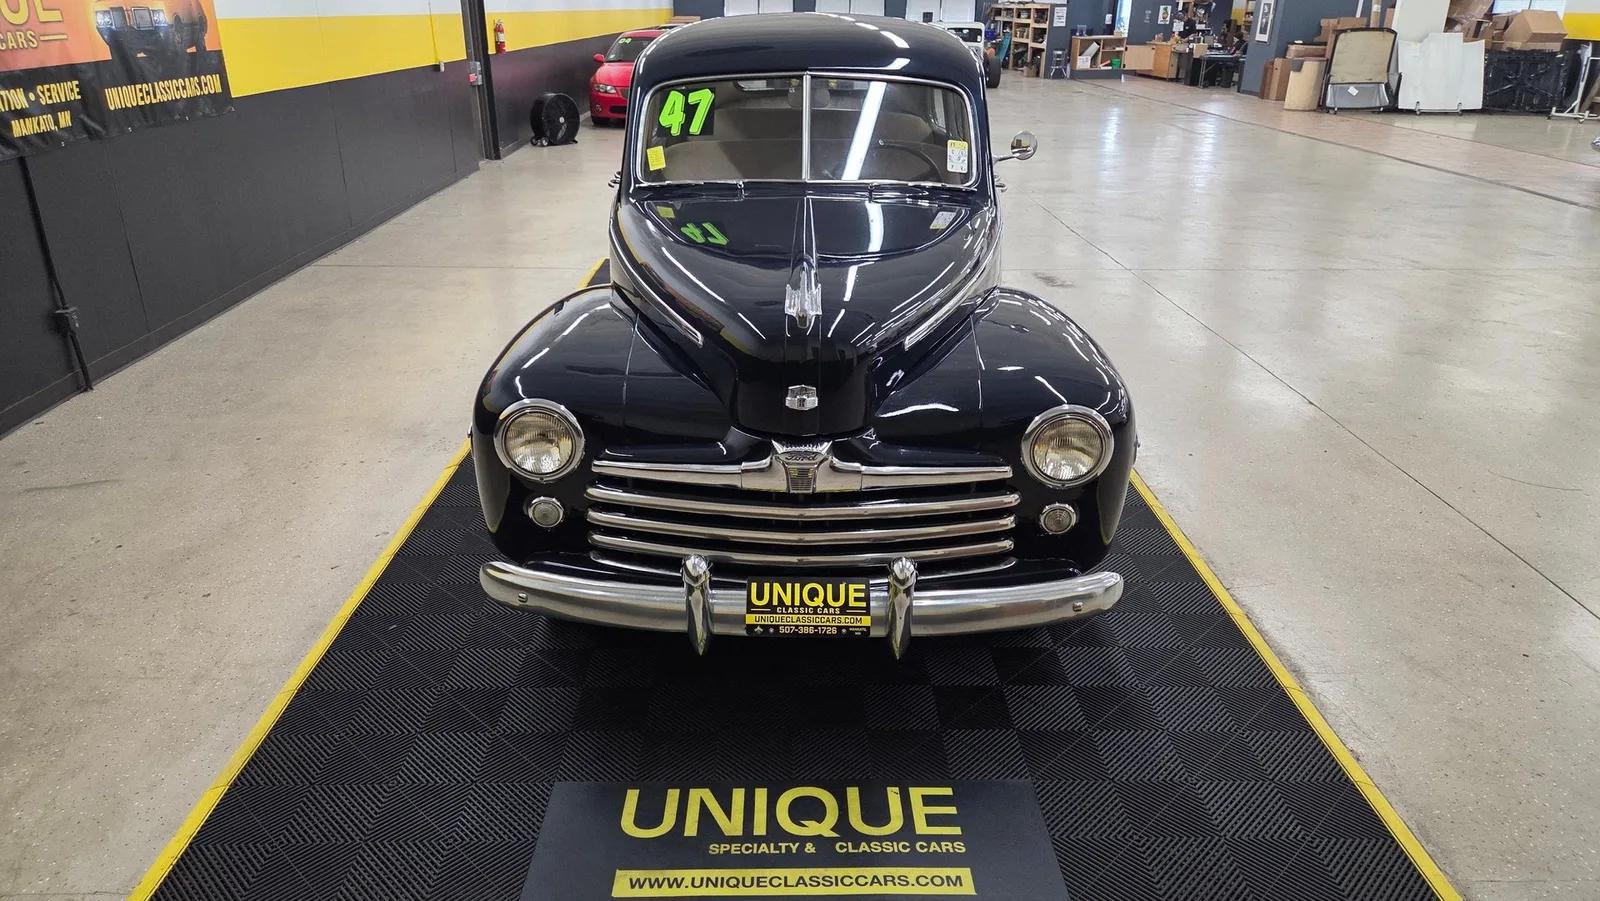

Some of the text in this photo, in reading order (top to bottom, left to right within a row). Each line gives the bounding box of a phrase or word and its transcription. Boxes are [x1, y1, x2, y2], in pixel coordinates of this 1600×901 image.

[36, 80, 82, 106] SERVICE
[104, 73, 222, 111] UNIQUECLASSICCARS.COM
[658, 88, 715, 136] 47
[11, 113, 59, 138] MANKATO,
[750, 582, 867, 607] UNIQUE
[754, 615, 863, 625] UNIQUECLASSICCARS.COM
[776, 606, 841, 615] CLASSIC CARS
[779, 626, 838, 635] 507-386-1726
[620, 786, 963, 839] UNIQUE
[708, 841, 967, 855] SPECIALTY & CLASSIC CARS
[629, 874, 964, 890] WWW.UNIQUECLASSICCARS.COM
